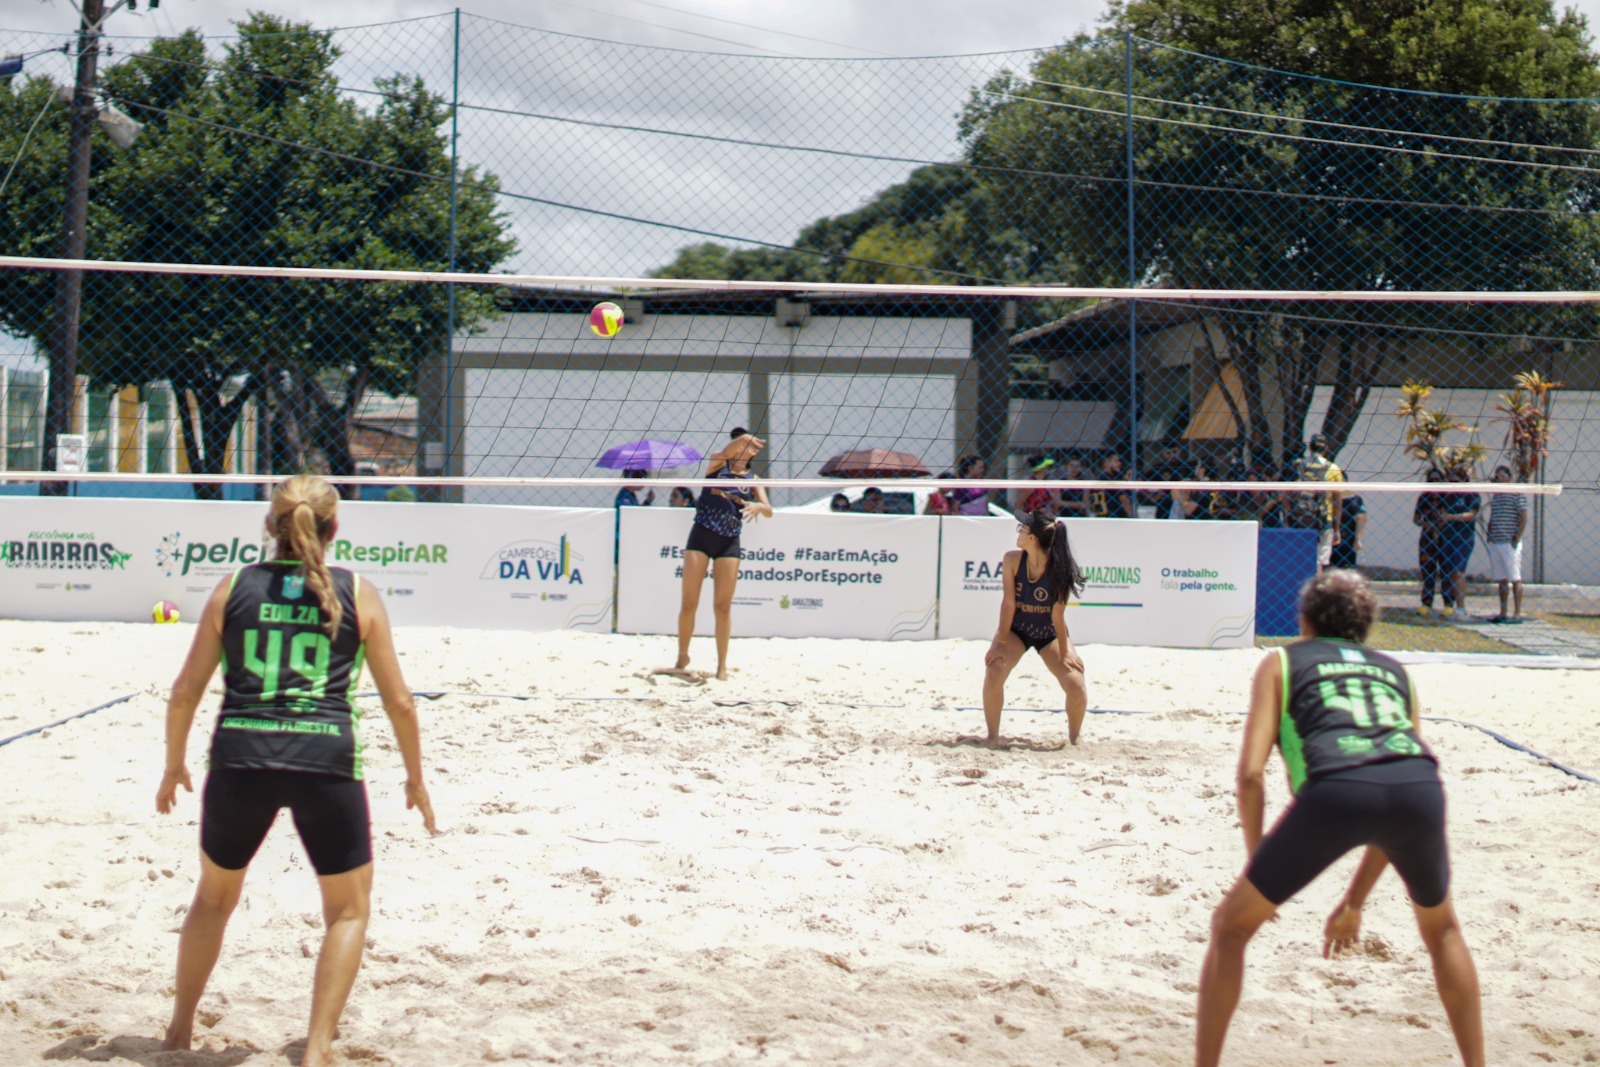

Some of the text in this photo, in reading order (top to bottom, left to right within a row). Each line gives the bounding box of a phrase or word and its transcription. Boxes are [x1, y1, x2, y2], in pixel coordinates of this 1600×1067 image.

[9, 541, 113, 567] BAIRROS
[498, 547, 557, 562] CAMPEÕES
[794, 547, 899, 566] #FaarEmAção
[499, 560, 530, 580] DA
[963, 560, 1003, 578] FAA
[1161, 567, 1219, 578] O trabalho
[1160, 579, 1237, 593] fala pela gente.
[259, 603, 319, 625] EDILZA
